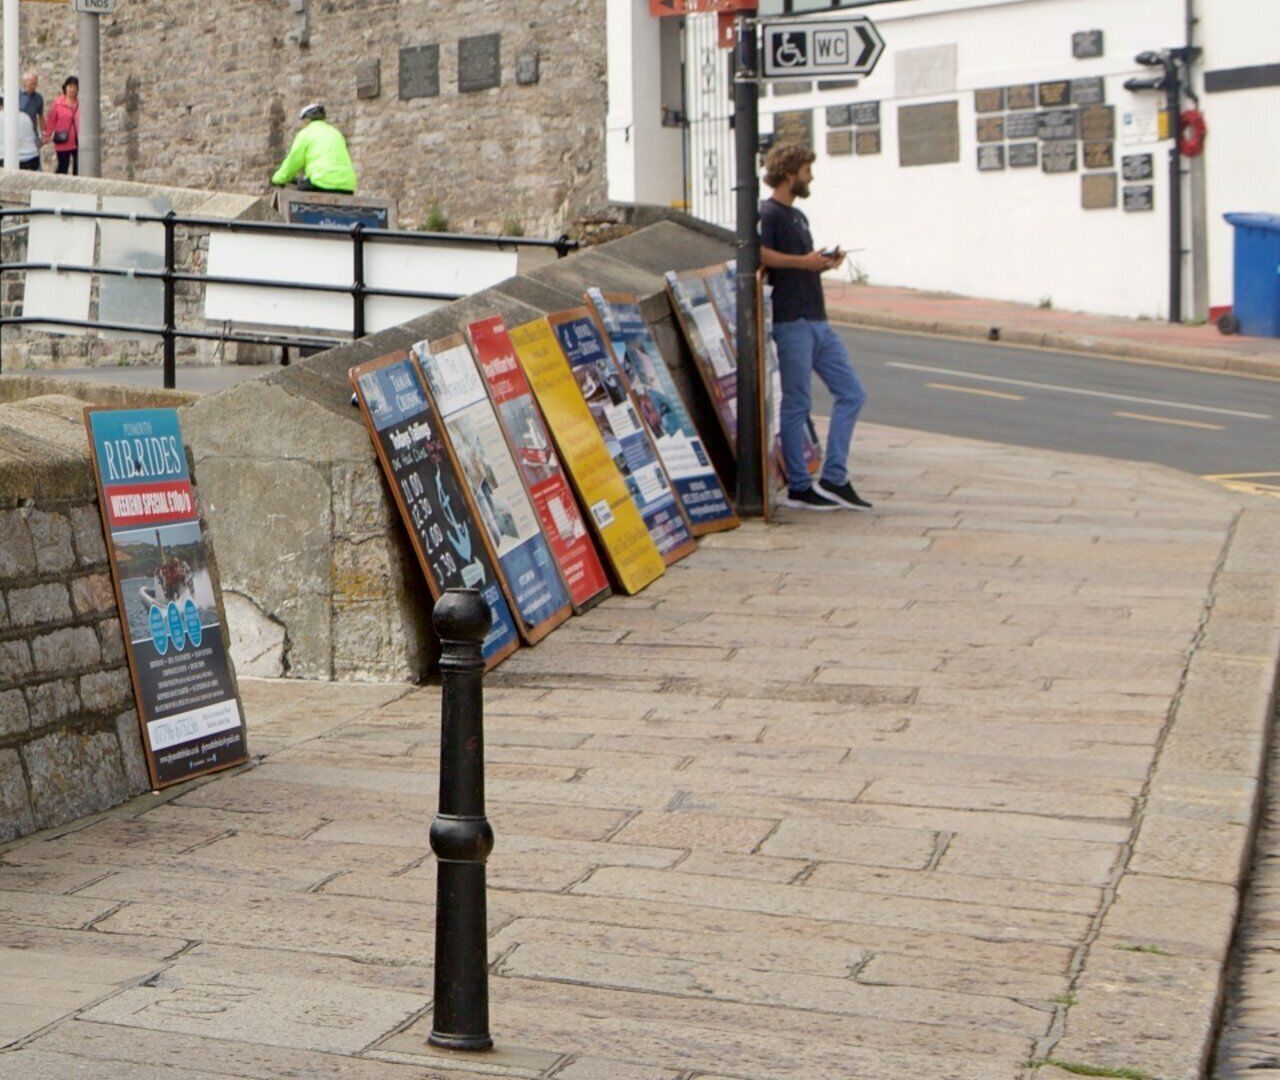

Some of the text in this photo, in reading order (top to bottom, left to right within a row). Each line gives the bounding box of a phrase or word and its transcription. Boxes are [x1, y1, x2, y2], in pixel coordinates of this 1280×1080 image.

[817, 37, 845, 57] WC
[103, 435, 181, 480] RIB RIDES
[110, 493, 144, 518] WEEKEND
[142, 491, 169, 516] SPECIAL
